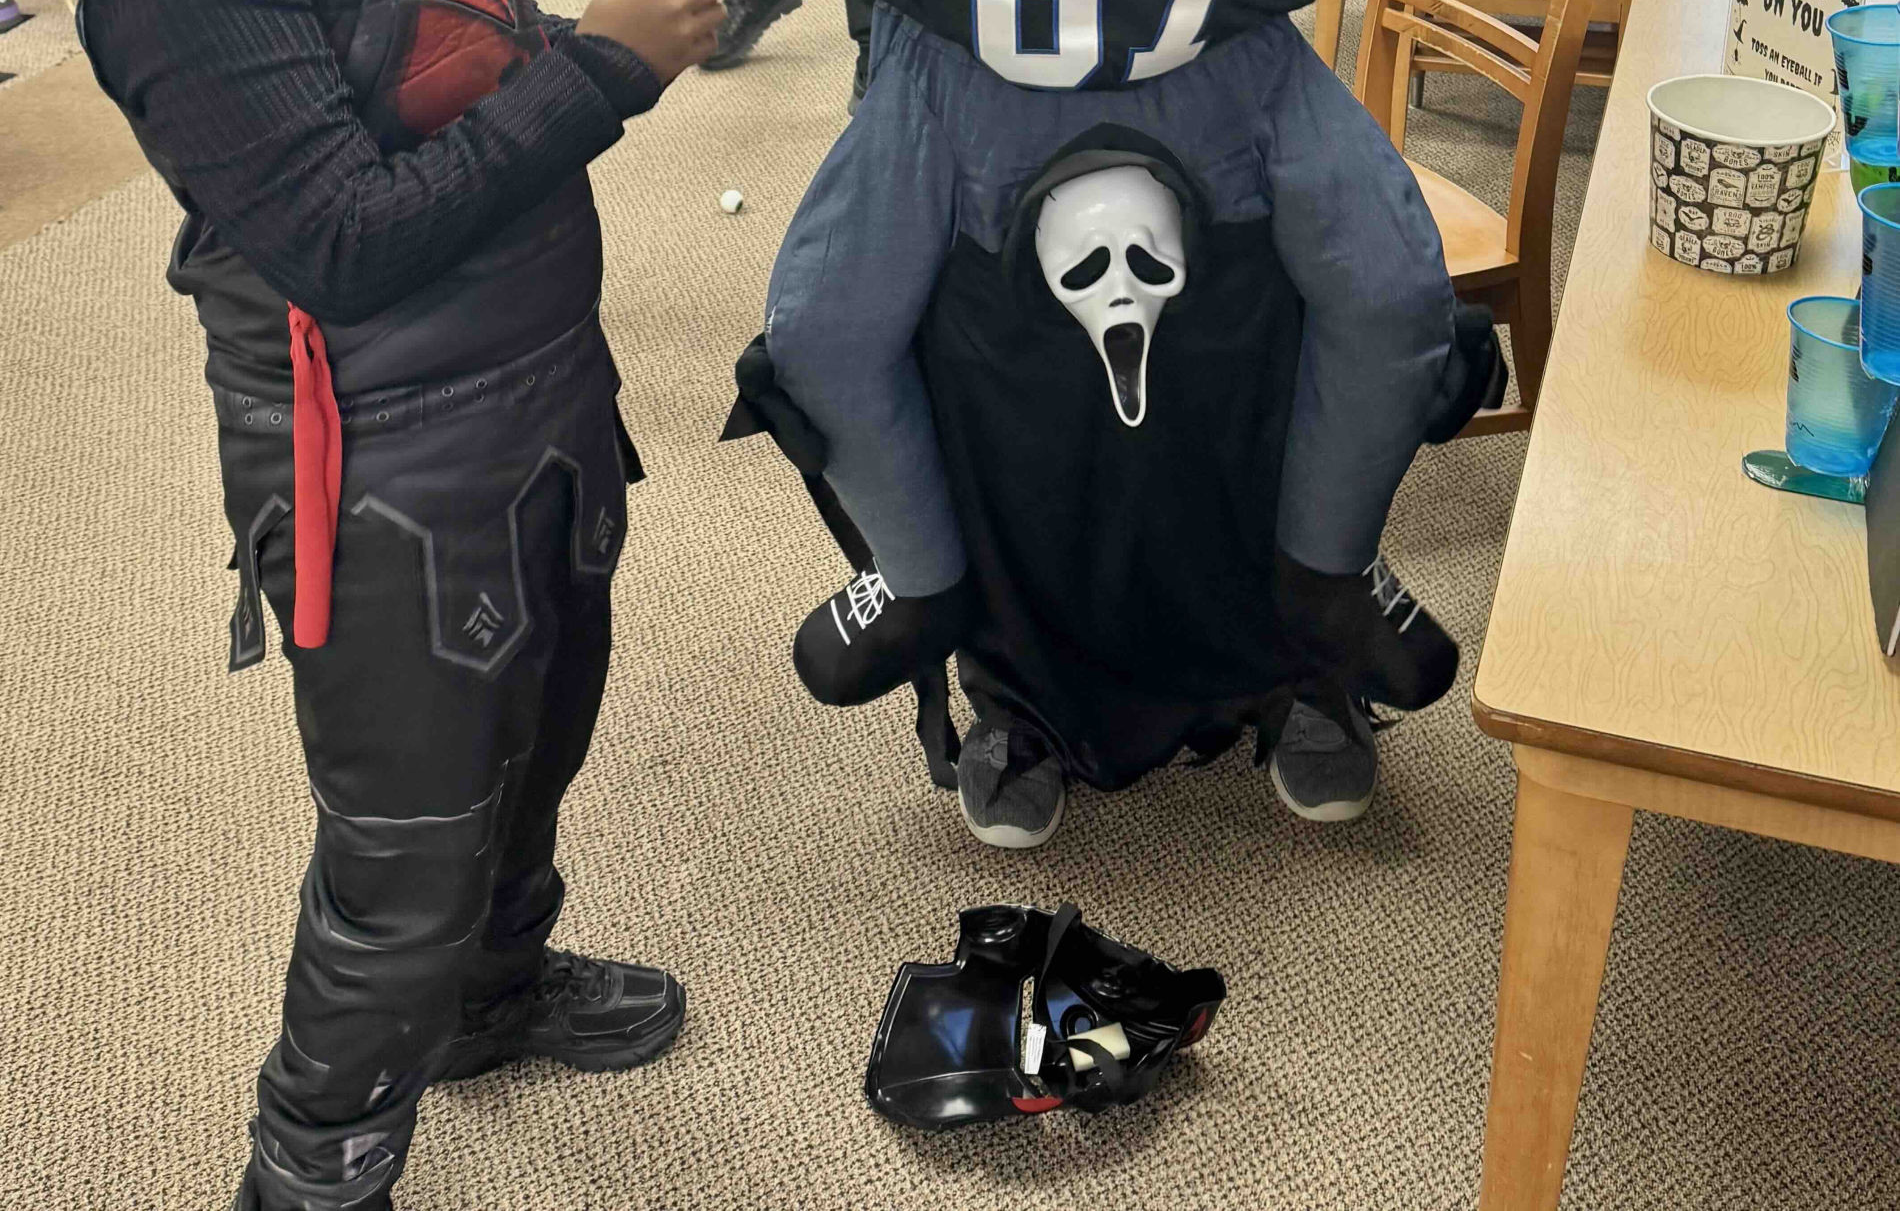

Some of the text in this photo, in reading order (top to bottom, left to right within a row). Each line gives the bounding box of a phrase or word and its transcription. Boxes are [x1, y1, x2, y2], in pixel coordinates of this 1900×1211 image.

[1751, 37, 1768, 57] TOSS
[1768, 48, 1780, 65] AN
[1781, 55, 1812, 83] EYEBALL
[1813, 72, 1823, 88] IF
[1764, 68, 1779, 83] YOU
